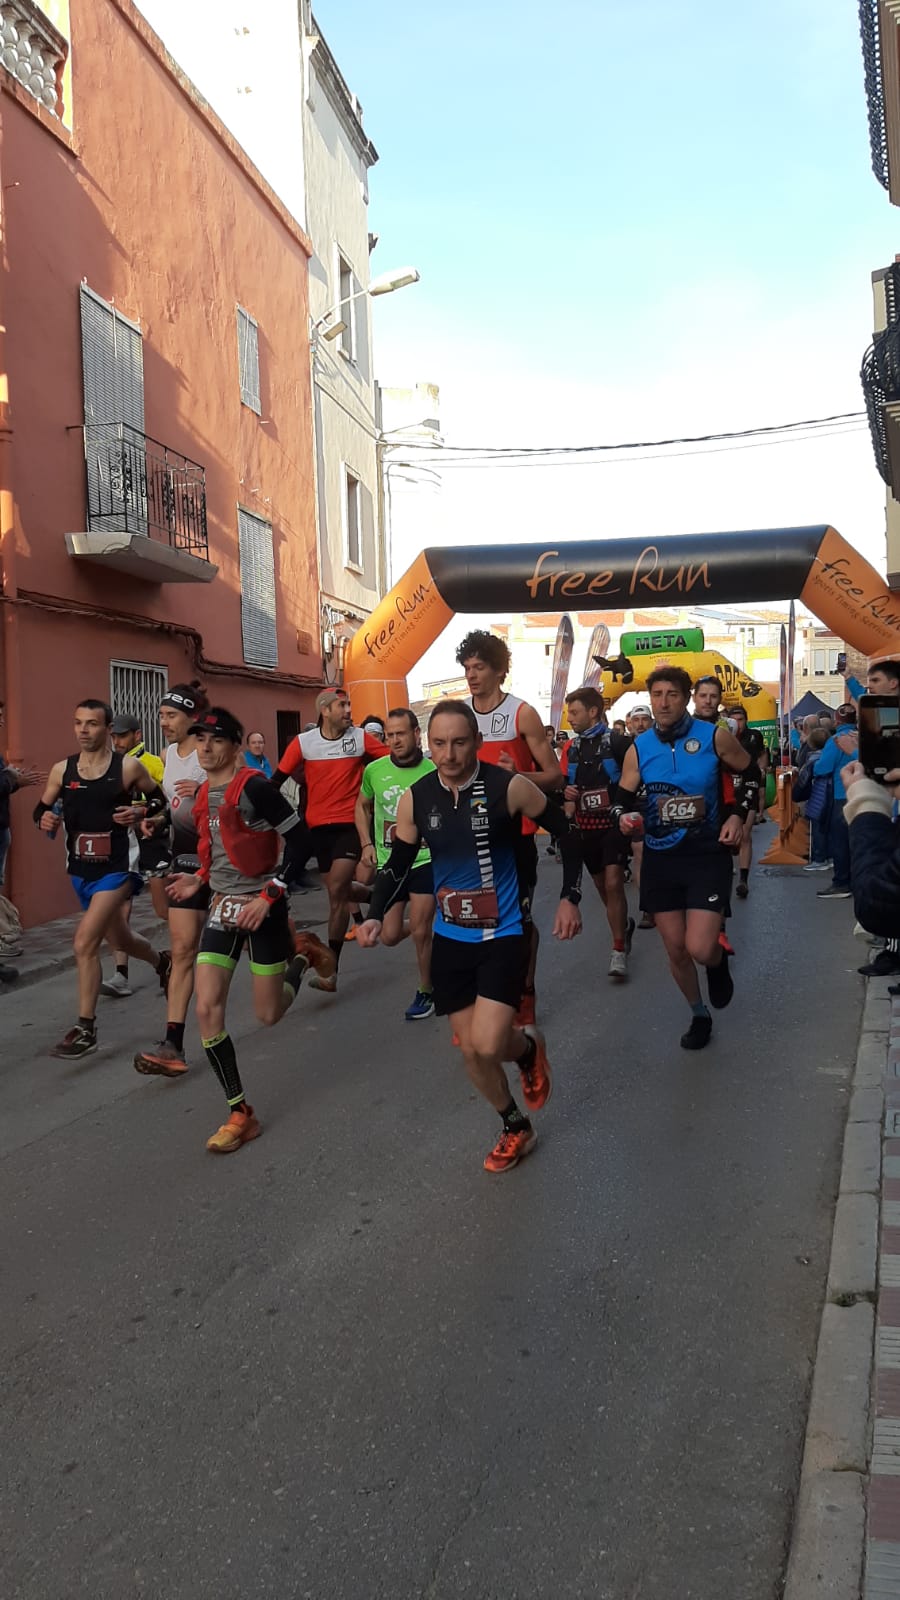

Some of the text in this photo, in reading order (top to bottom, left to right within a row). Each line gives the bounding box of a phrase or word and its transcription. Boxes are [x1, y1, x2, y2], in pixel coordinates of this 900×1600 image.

[525, 546, 711, 599] free Run
[822, 558, 864, 603] free
[364, 583, 430, 658] free Run
[635, 634, 687, 651] META
[585, 794, 602, 806] 151
[668, 802, 697, 817] 264
[84, 839, 95, 854] 1
[223, 901, 244, 920] 31
[461, 899, 474, 915] 5
